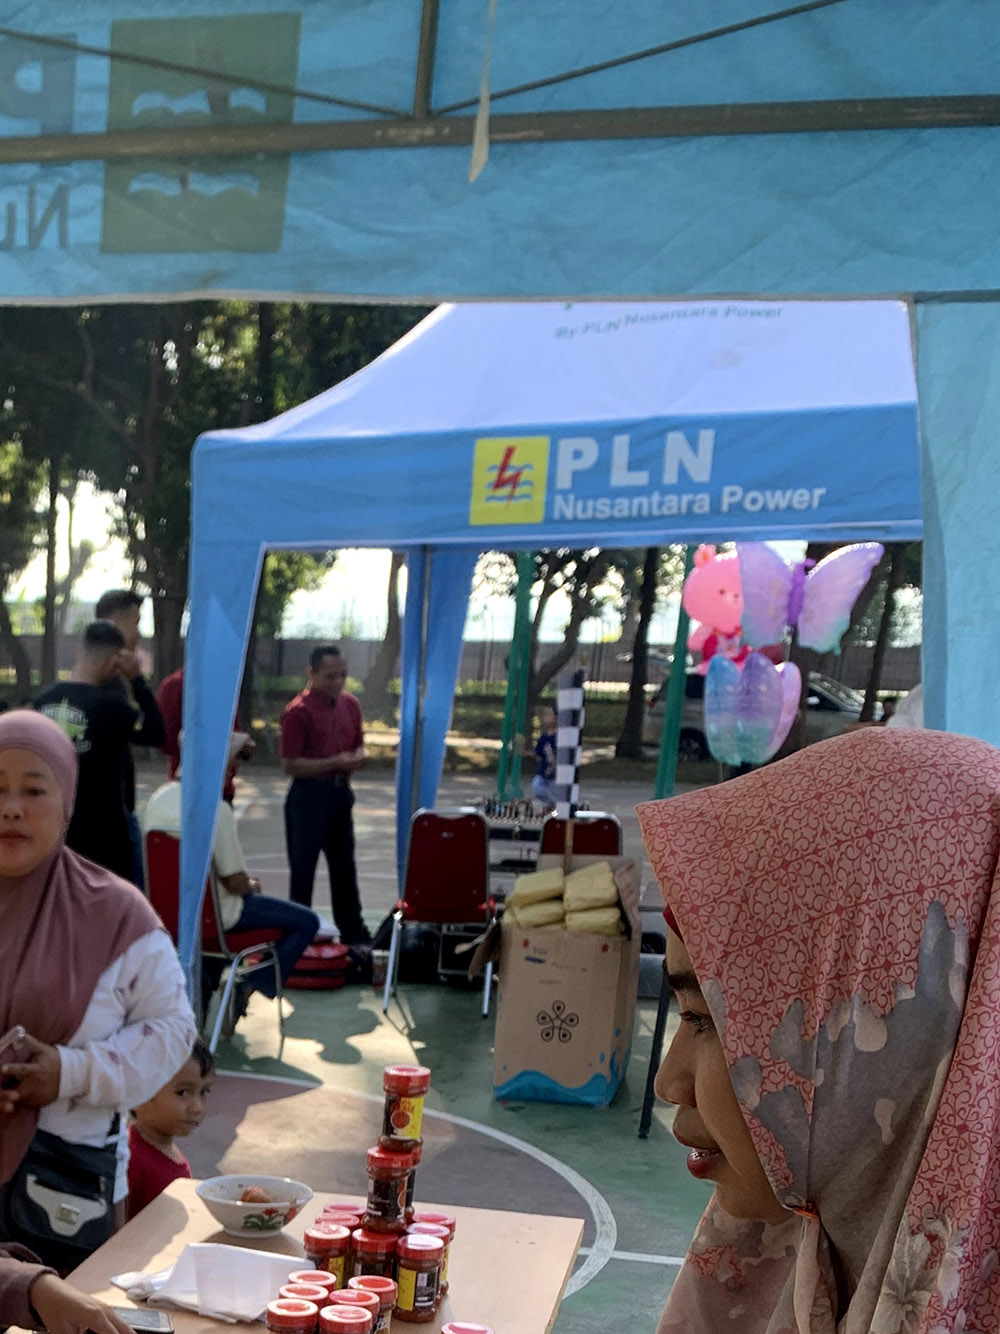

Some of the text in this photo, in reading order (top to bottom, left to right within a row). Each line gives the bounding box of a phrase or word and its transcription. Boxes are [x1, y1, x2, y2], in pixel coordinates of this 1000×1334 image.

[625, 305, 719, 326] Nusantara
[723, 304, 784, 319] Power
[556, 428, 716, 490] PLN
[553, 485, 827, 520] Nusantara Power
